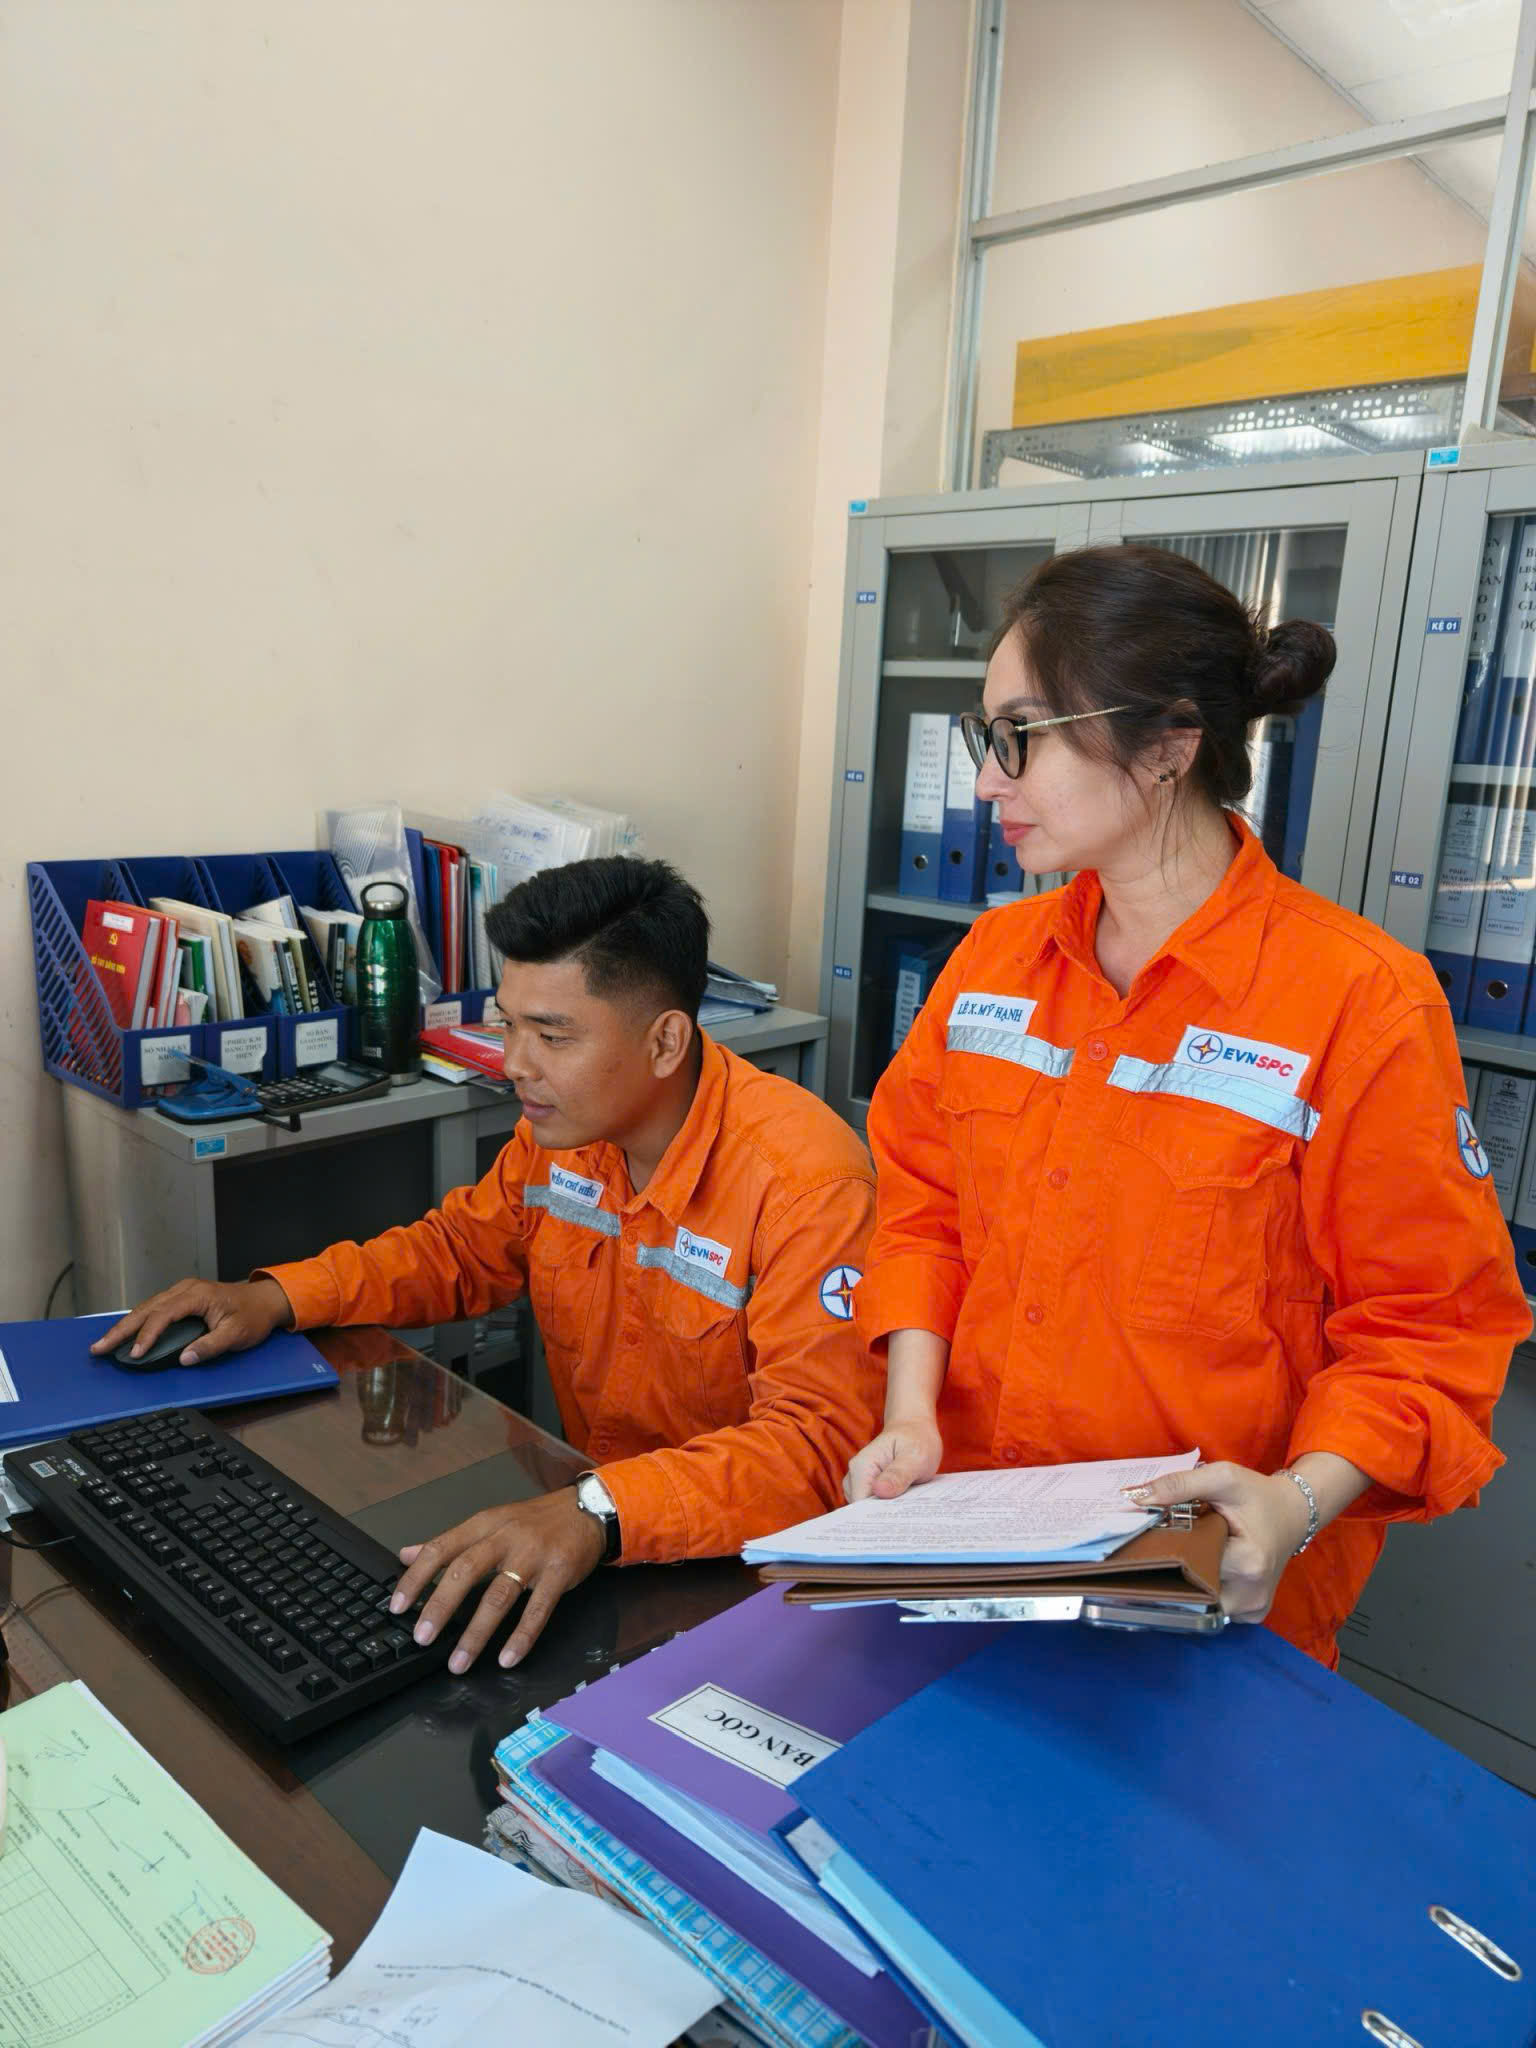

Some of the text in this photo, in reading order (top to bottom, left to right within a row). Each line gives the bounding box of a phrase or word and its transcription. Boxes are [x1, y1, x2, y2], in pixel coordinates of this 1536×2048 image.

[1446, 621, 1457, 631] 01
[1408, 875, 1420, 886] 02
[957, 1000, 968, 1015] LÊ
[998, 1005, 1024, 1022] HẠNH
[1222, 1047, 1293, 1077] EVNSPC
[690, 1245, 724, 1267] EVNSPC
[704, 1709, 817, 1768] BẢN GỐC
